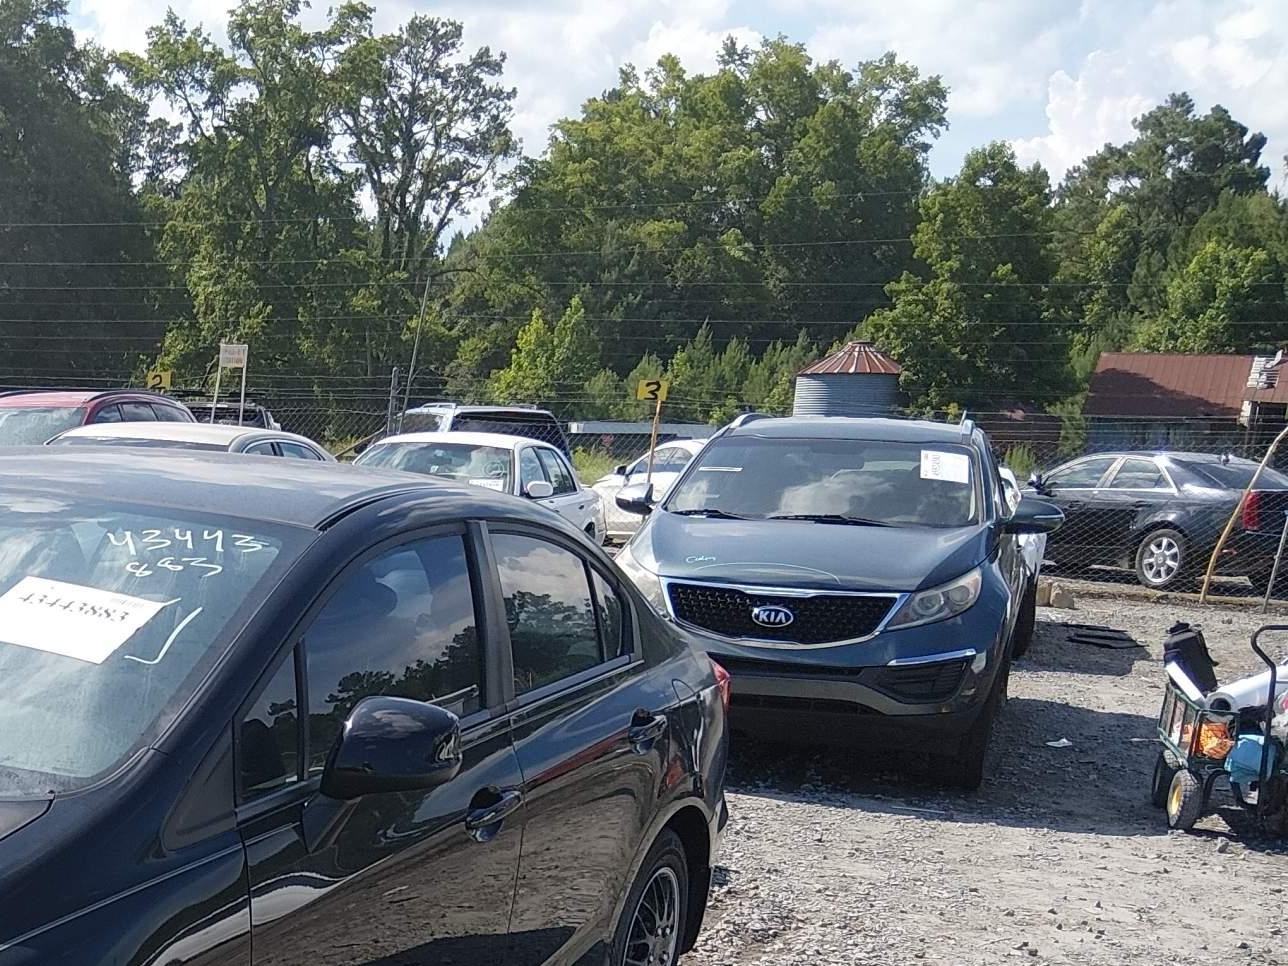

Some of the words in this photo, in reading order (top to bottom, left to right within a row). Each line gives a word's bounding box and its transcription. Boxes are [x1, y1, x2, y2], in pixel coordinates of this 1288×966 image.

[150, 374, 167, 390] 2
[643, 380, 662, 400] 3
[106, 528, 270, 556] 43443
[124, 556, 223, 578] 883
[758, 610, 786, 623] KIA
